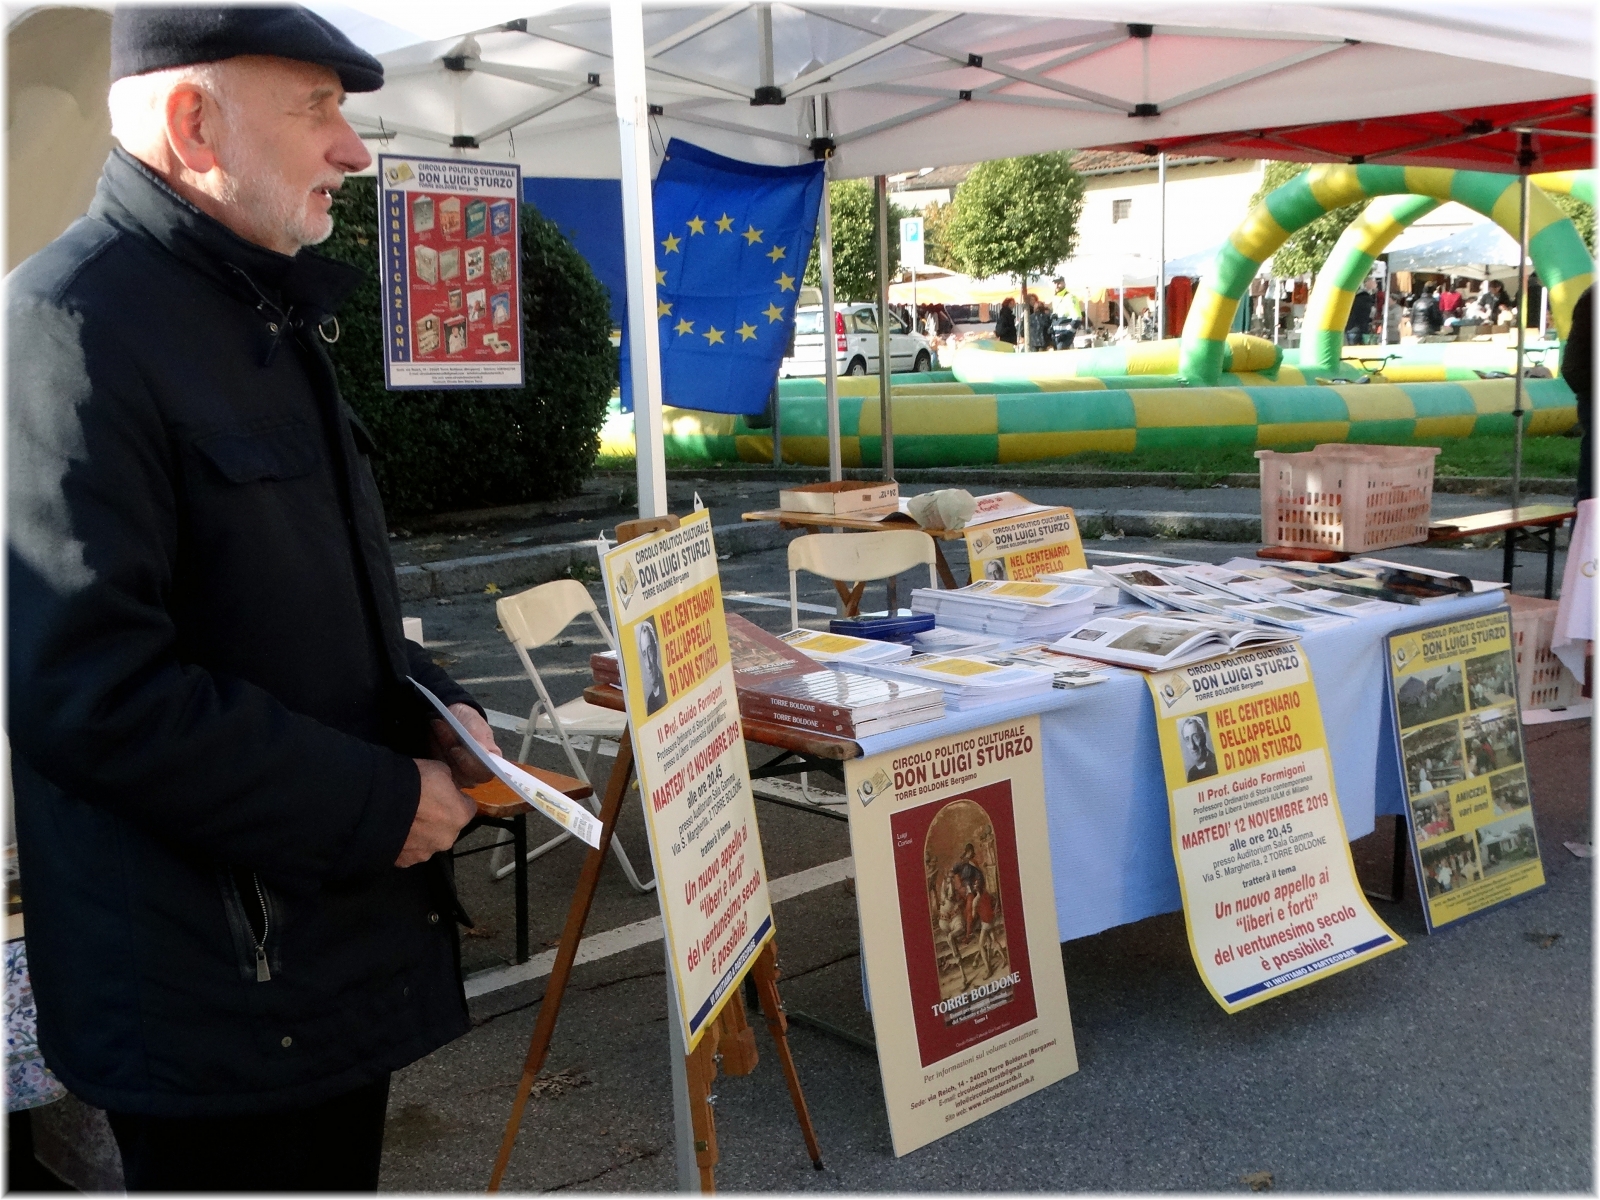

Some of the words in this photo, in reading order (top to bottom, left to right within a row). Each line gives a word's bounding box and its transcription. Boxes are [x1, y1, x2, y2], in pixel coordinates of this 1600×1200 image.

[418, 163, 446, 171] CIRCOLO
[449, 165, 478, 174] POLITICO
[480, 168, 515, 177] CULTURALE
[419, 173, 439, 182] DON
[444, 174, 470, 185] LUIGI
[474, 177, 512, 188] STURZO
[391, 193, 404, 360] PUBBLICAZIONI
[636, 544, 658, 564] CIRCOLO
[659, 534, 682, 553] POLITICO
[683, 521, 709, 542] CULTURALE
[993, 525, 1015, 534] CIRCOLO
[1017, 520, 1040, 529] POLITICO
[1041, 514, 1069, 524] CULTURALE
[996, 534, 1012, 545] DON
[1015, 528, 1036, 540] LUIGI
[1039, 522, 1070, 535] STURZO
[639, 562, 658, 587] DON
[660, 552, 681, 578] LUIGI
[682, 538, 710, 566] STURZO
[1010, 555, 1023, 567] NEL
[1026, 545, 1070, 563] CENTENARIO
[1012, 560, 1063, 580] DELL'APPELLO
[660, 610, 676, 638] NEL
[675, 586, 715, 629] CENTENARIO
[665, 618, 711, 667] DELL'APPELLO
[1188, 662, 1220, 676] CIRCOLO
[1223, 654, 1256, 668] POLITICO
[1256, 645, 1296, 660] CULTURALE
[1423, 641, 1442, 656] DON
[1445, 635, 1469, 651] LUIGI
[1472, 626, 1506, 645] STURZO
[669, 671, 679, 696] DI
[678, 660, 695, 690] DON
[695, 643, 718, 680] STURZO
[1192, 676, 1218, 692] DON
[1222, 668, 1253, 686] LUIGI
[1256, 655, 1299, 678] STURZO
[770, 698, 788, 707] TORRE
[790, 702, 815, 712] BOLDONE
[1195, 692, 1214, 701] TORRE
[1215, 686, 1240, 697] BOLDONE
[1241, 679, 1263, 690] Bergamo
[1215, 709, 1236, 728] NEL
[1238, 690, 1300, 722] CENTENARIO
[658, 728, 664, 744] Il
[664, 717, 678, 739] Prof.
[679, 705, 697, 726] Guido
[698, 680, 722, 713] Formigoni
[774, 713, 791, 722] TORRE
[792, 716, 818, 727] BOLDONE
[893, 751, 931, 770] CIRCOLO
[935, 739, 975, 759] POLITICO
[978, 725, 1025, 747] CULTURALE
[1219, 715, 1291, 750] DELL'APPELLO
[1224, 752, 1236, 770] DI
[1238, 747, 1260, 766] DON
[1262, 733, 1302, 760] STURZO
[652, 767, 685, 813] MARTEDI'
[687, 760, 695, 783] 12
[694, 731, 728, 775] NOVEMBRE
[727, 721, 739, 747] 2019
[894, 765, 927, 790] DON
[932, 752, 972, 780] LUIGI
[977, 735, 1033, 767] STURZO
[1198, 792, 1204, 803] Il
[1208, 786, 1229, 800] Prof.
[1232, 778, 1258, 792] Guido
[1261, 761, 1305, 785] Formigoni
[686, 788, 697, 809] alle
[698, 780, 707, 796] ore
[707, 764, 722, 788] 20,45
[895, 789, 917, 801] TORRE
[919, 780, 949, 795] BOLDONE
[950, 772, 977, 786] Bergamo
[1193, 802, 1223, 815] Professore
[1224, 794, 1249, 807] Ordinario
[1256, 786, 1272, 797] Storia
[1273, 775, 1313, 793] contemporanea
[1199, 813, 1217, 824] presso
[1219, 809, 1224, 817] la
[1225, 805, 1242, 815] Libera
[1243, 797, 1269, 810] Università
[1271, 793, 1285, 803] IULM
[1286, 790, 1291, 798] di
[1292, 785, 1309, 796] Milano
[1182, 821, 1230, 850] MARTEDI'
[1234, 817, 1245, 833] 12
[1248, 799, 1305, 830] NOVEMBRE
[1307, 793, 1329, 812] 2019
[1229, 838, 1247, 852] alle
[1250, 834, 1265, 846] ore
[1267, 822, 1293, 838] 20,45
[685, 880, 696, 905] Un
[698, 861, 719, 891] nuovo
[721, 830, 742, 869] appello
[742, 817, 747, 842] ai
[1202, 872, 1214, 883] Via
[1215, 868, 1223, 878] S.
[1224, 857, 1263, 877] Margherita,
[1263, 854, 1269, 864] 2
[1269, 847, 1293, 861] TORRE
[1294, 836, 1327, 853] BOLDONE
[1212, 857, 1235, 870] presso
[1237, 844, 1272, 861] Auditorium
[1273, 838, 1288, 849] Sala
[1288, 830, 1313, 844] Gamma
[1215, 901, 1232, 919] Un
[1236, 891, 1270, 913] nuovo
[1274, 873, 1316, 901] appello
[1319, 866, 1330, 884] ai
[1242, 870, 1271, 889] tratterà
[1272, 868, 1277, 877] il
[1278, 865, 1296, 876] tema
[688, 940, 701, 972] del
[702, 897, 741, 952] ventunesimo
[742, 869, 760, 902] secolo
[1277, 909, 1285, 920] e
[711, 952, 716, 975] è
[718, 911, 748, 968] possibile?
[1214, 944, 1235, 966] del
[1237, 920, 1315, 957] ventunesimo
[1317, 906, 1357, 929] secolo
[1261, 955, 1271, 972] è
[1272, 932, 1334, 970] possibile?
[1272, 968, 1308, 986] INVITIAMO
[1307, 965, 1313, 973] A
[1313, 949, 1358, 971] PARTECIPARE
[932, 992, 969, 1016] TORRE
[970, 971, 1021, 1001] BOLDONE
[911, 1099, 927, 1110] Sede:
[928, 1094, 937, 1102] via
[938, 1086, 957, 1098] Reich,
[958, 1080, 965, 1088] 14
[970, 1071, 988, 1083] 24020
[988, 1064, 1004, 1074] Torre
[1005, 1053, 1028, 1066] Boldone
[1029, 1038, 1056, 1057] (Bergamo)
[924, 1073, 935, 1084] Per
[936, 1056, 974, 1078] informazioni
[976, 1051, 985, 1061] sul
[986, 1042, 1007, 1055] volume
[1009, 1028, 1039, 1046] contattare:
